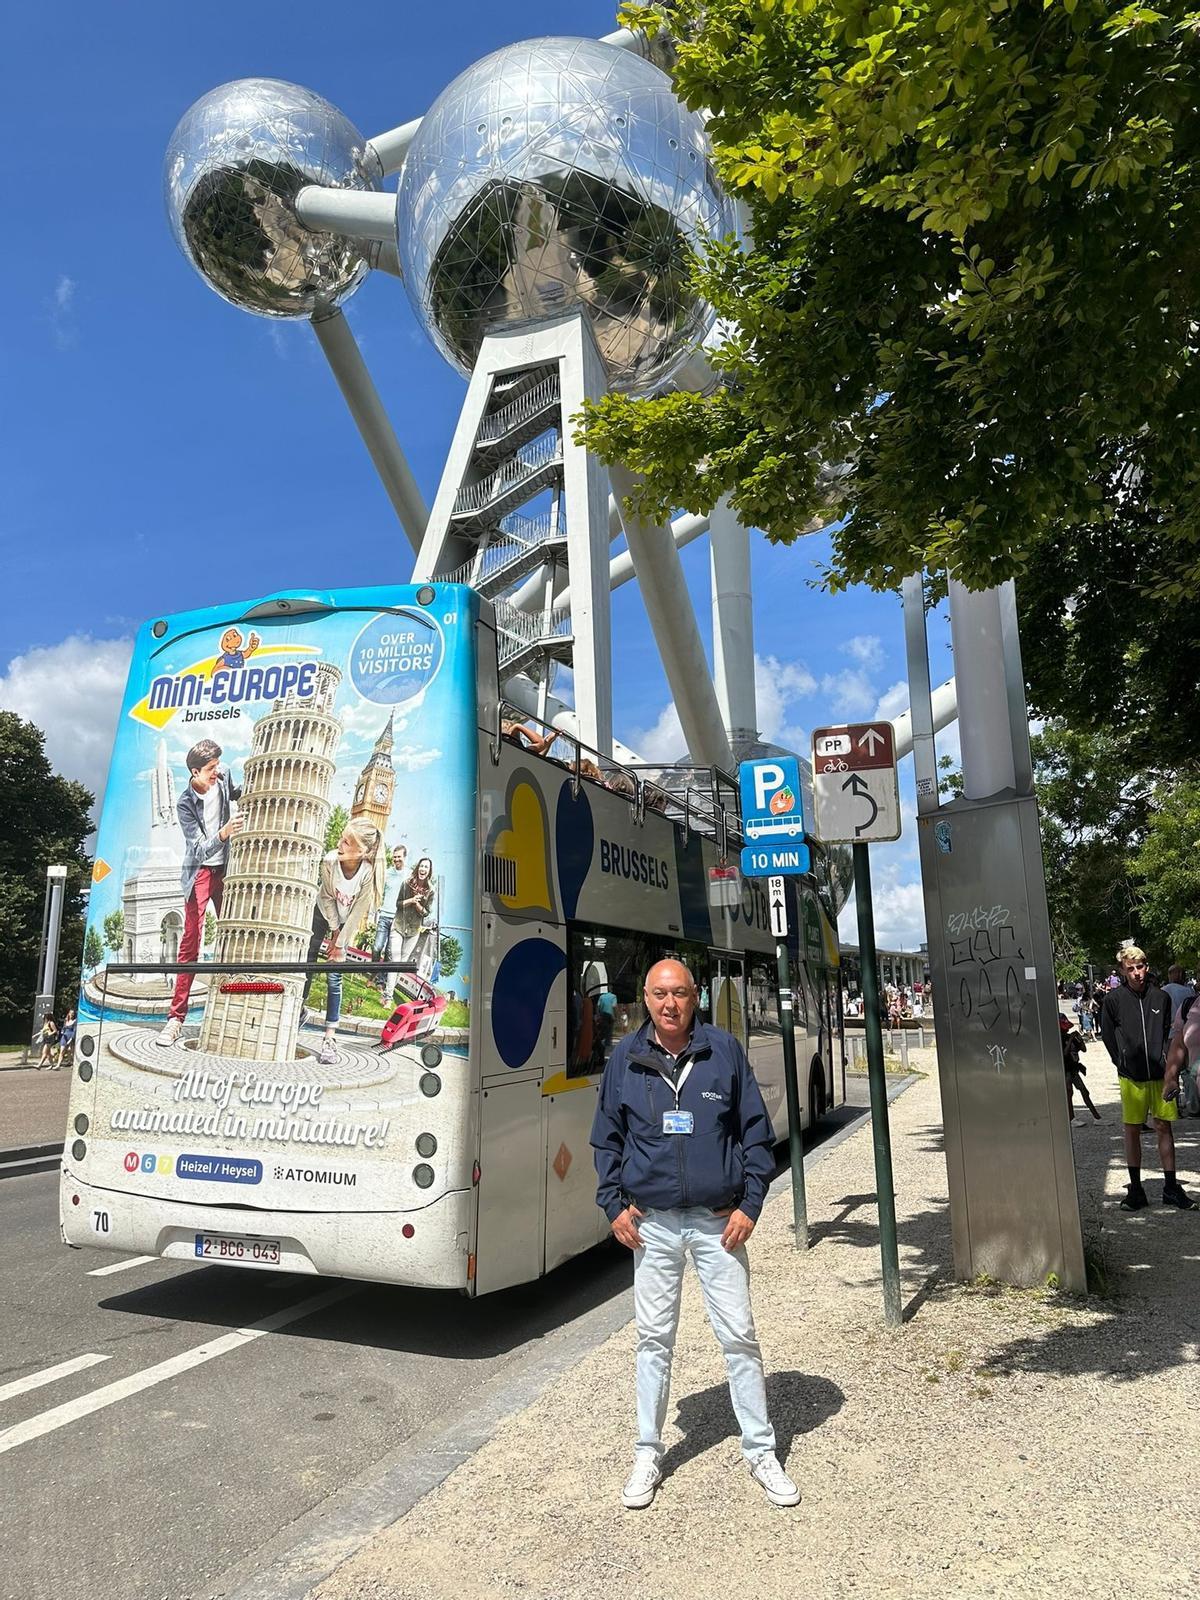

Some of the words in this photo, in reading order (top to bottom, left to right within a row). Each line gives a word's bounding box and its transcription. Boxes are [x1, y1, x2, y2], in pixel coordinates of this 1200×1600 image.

[380, 632, 415, 646] OVER
[360, 648, 374, 660] 10
[377, 643, 434, 658] MILLION
[358, 656, 433, 675] VISITORS
[181, 706, 241, 723] .brussels
[825, 739, 842, 752] PP
[753, 763, 785, 810] P
[599, 838, 669, 890] BRUSSELS
[752, 854, 768, 869] 10
[773, 851, 799, 868] MIN
[770, 878, 782, 888] 18
[173, 1070, 209, 1102] All
[211, 1071, 239, 1110] of
[240, 1072, 324, 1115] Europe
[110, 1103, 222, 1136] animated
[224, 1109, 249, 1138] in
[252, 1110, 390, 1148] miniature!
[126, 1155, 138, 1168] M
[144, 1157, 153, 1169] 6
[180, 1160, 212, 1174] Heizel
[221, 1163, 257, 1179] Heysel
[285, 1168, 357, 1187] ATOMIUM
[93, 1211, 109, 1233] 70
